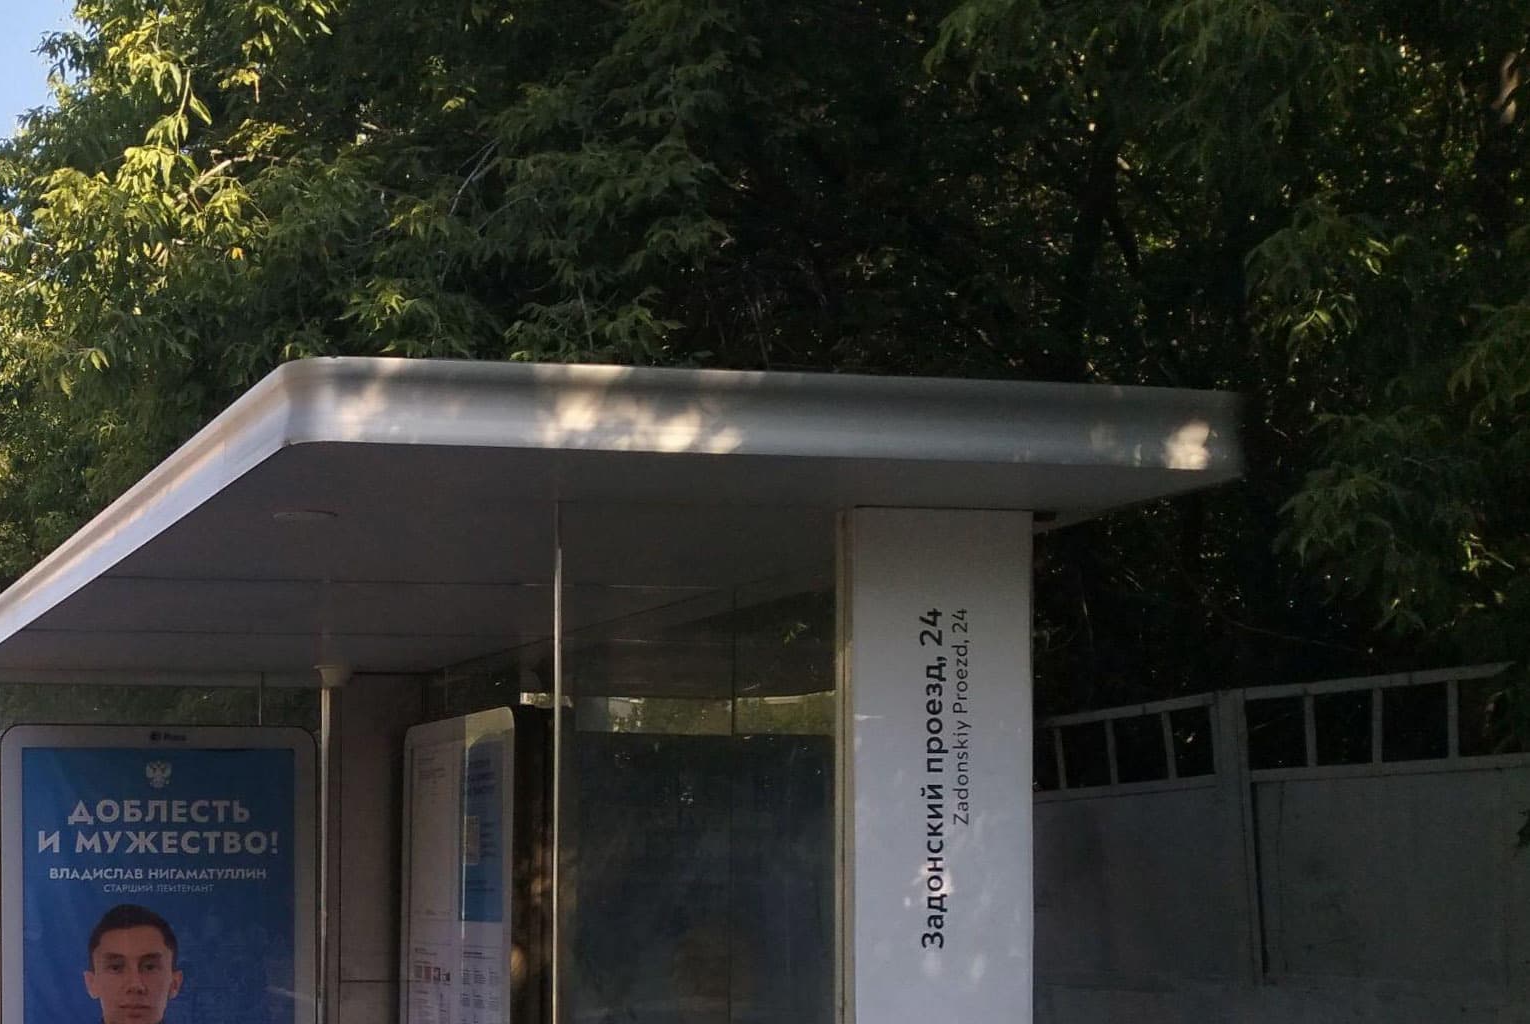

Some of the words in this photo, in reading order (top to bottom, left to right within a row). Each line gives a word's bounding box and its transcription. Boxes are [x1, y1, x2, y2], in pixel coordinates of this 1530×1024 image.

[919, 608, 943, 646] 24
[951, 608, 968, 633] 24
[951, 640, 970, 714] Proezd,
[926, 656, 949, 773] проезд,
[952, 720, 972, 825] Zadonskiy
[67, 799, 251, 825] ДОБЛЕСТЬ
[38, 831, 60, 853] И
[75, 831, 279, 854] МУЖЕСТВО!
[49, 867, 143, 881] ВЛАДИСЛАВ
[148, 867, 267, 881] НИГАМАТУЛЛИН
[920, 784, 948, 949] Задонский
[103, 882, 153, 894] СТАРШИЙ
